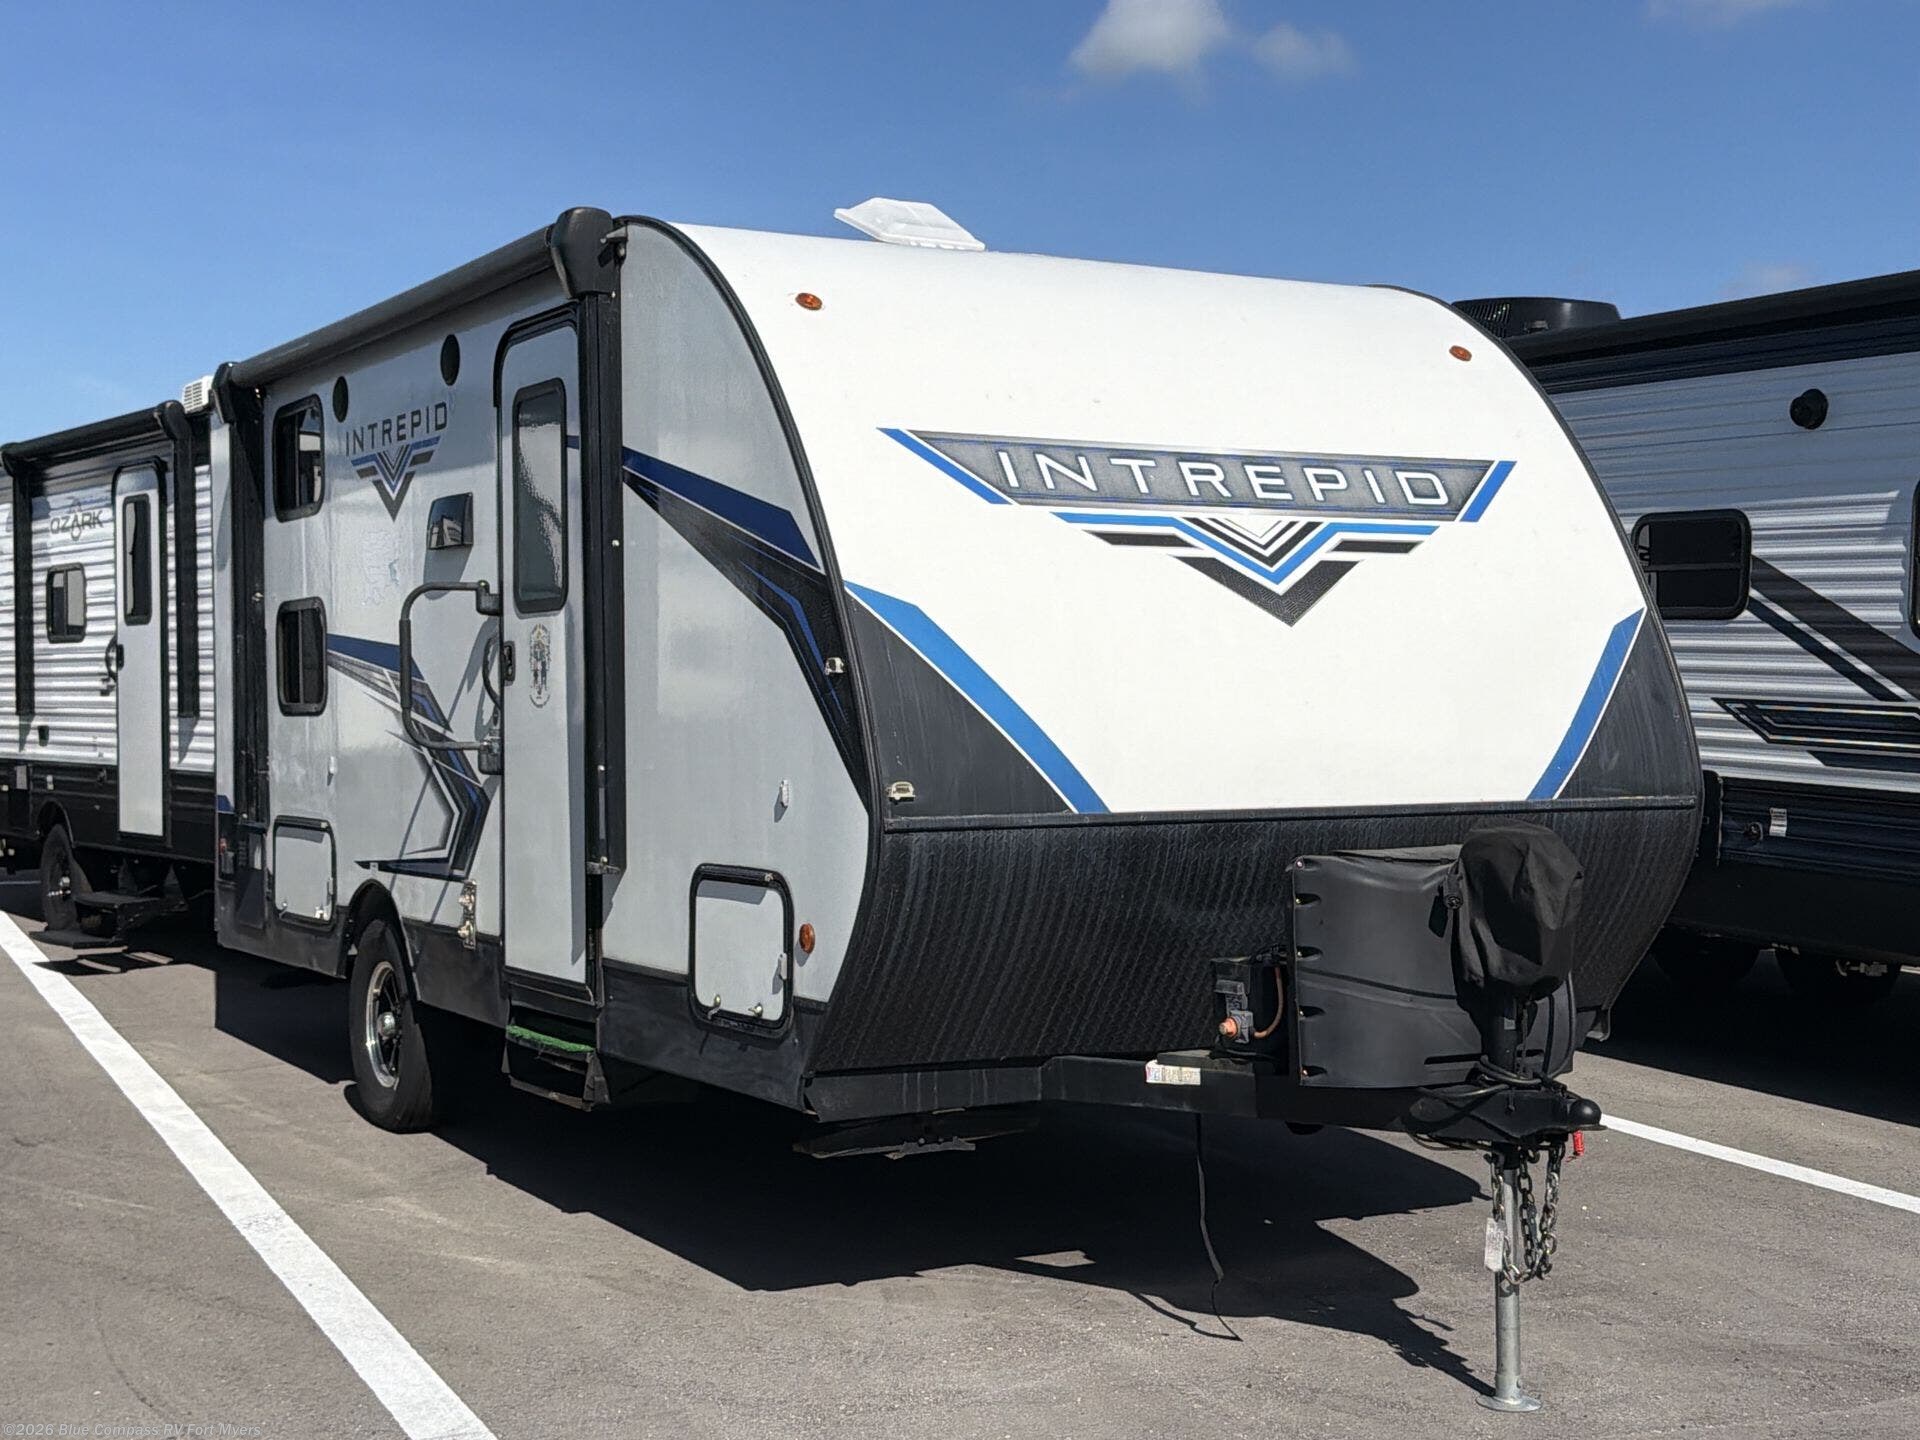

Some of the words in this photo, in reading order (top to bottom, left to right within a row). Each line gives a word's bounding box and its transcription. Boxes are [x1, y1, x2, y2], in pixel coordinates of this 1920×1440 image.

[346, 401, 448, 457] INTREPID
[994, 450, 1450, 507] INTREPID
[50, 510, 104, 540] OZARK
